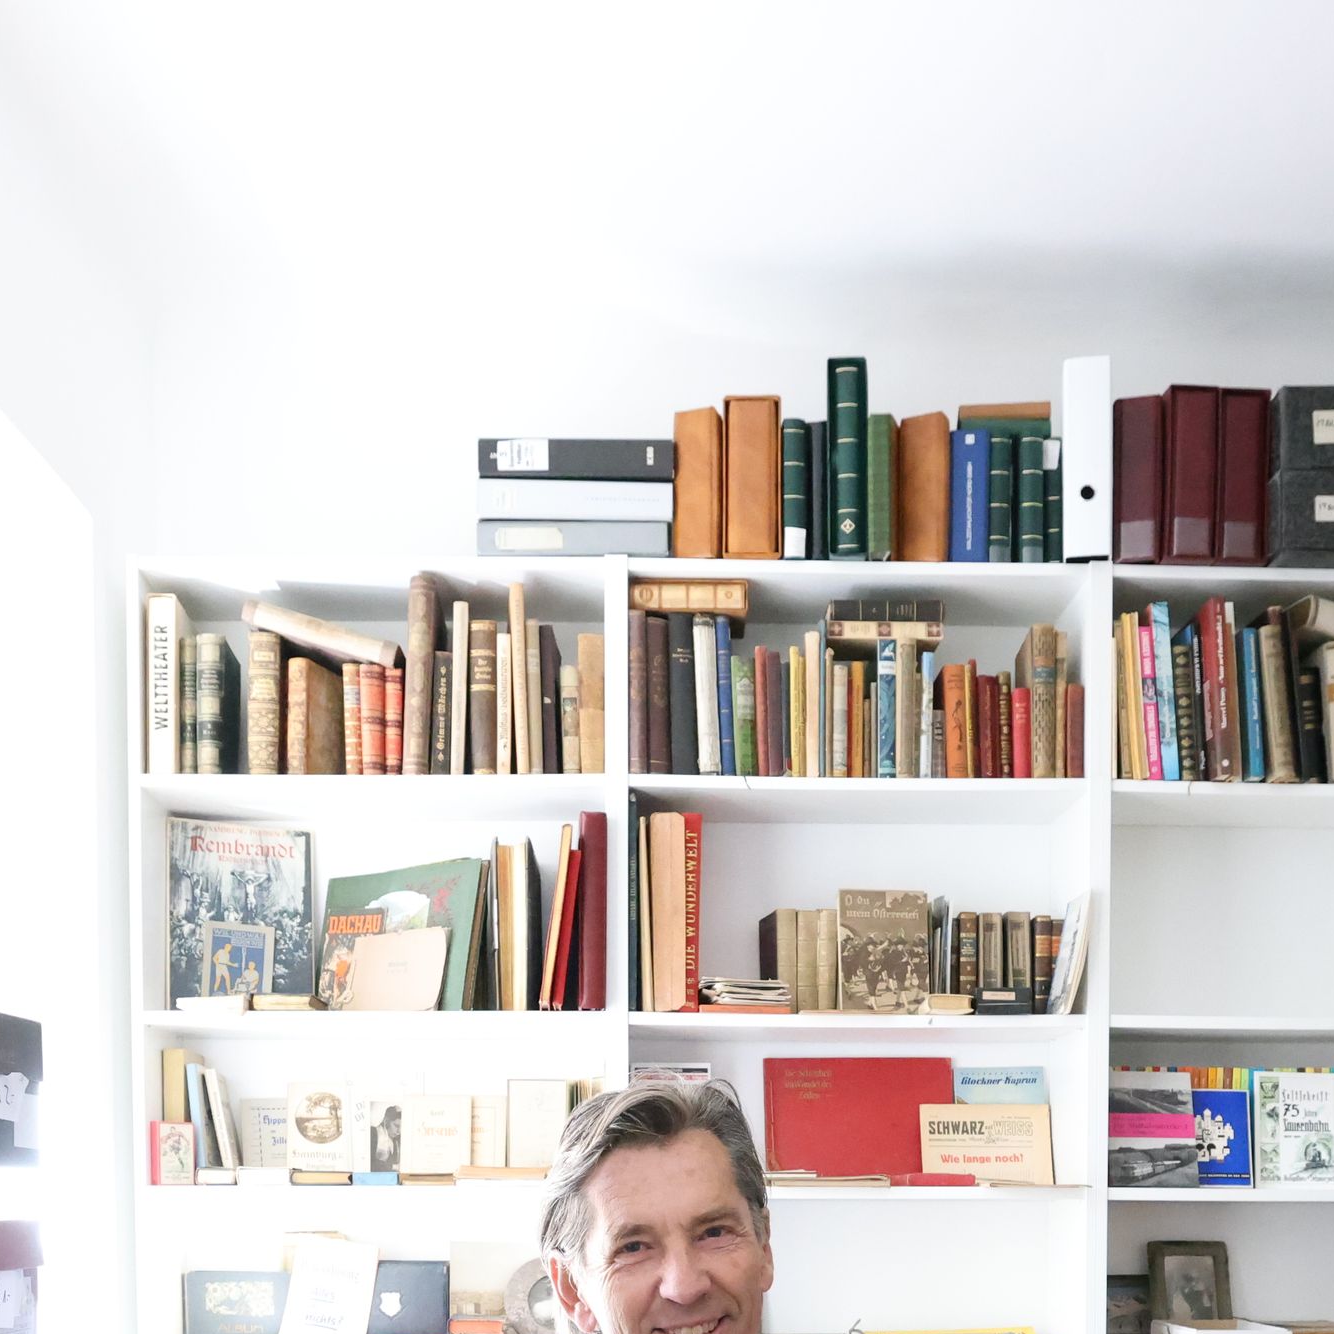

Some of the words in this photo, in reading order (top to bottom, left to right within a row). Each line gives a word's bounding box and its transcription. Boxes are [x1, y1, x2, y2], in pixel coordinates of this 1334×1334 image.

[154, 625, 168, 730] WELTTHEATER
[190, 835, 296, 859] Rembrandt
[685, 829, 699, 937] WUNDERWELT
[329, 914, 383, 935] DACHAU
[685, 943, 697, 970] DIE
[1282, 1104, 1300, 1118] 75
[928, 1119, 985, 1136] SCHWARZ
[992, 1119, 1034, 1138] WEISS
[940, 1153, 961, 1164] Wie
[962, 1153, 992, 1165] lange
[994, 1152, 1024, 1164] noch!
